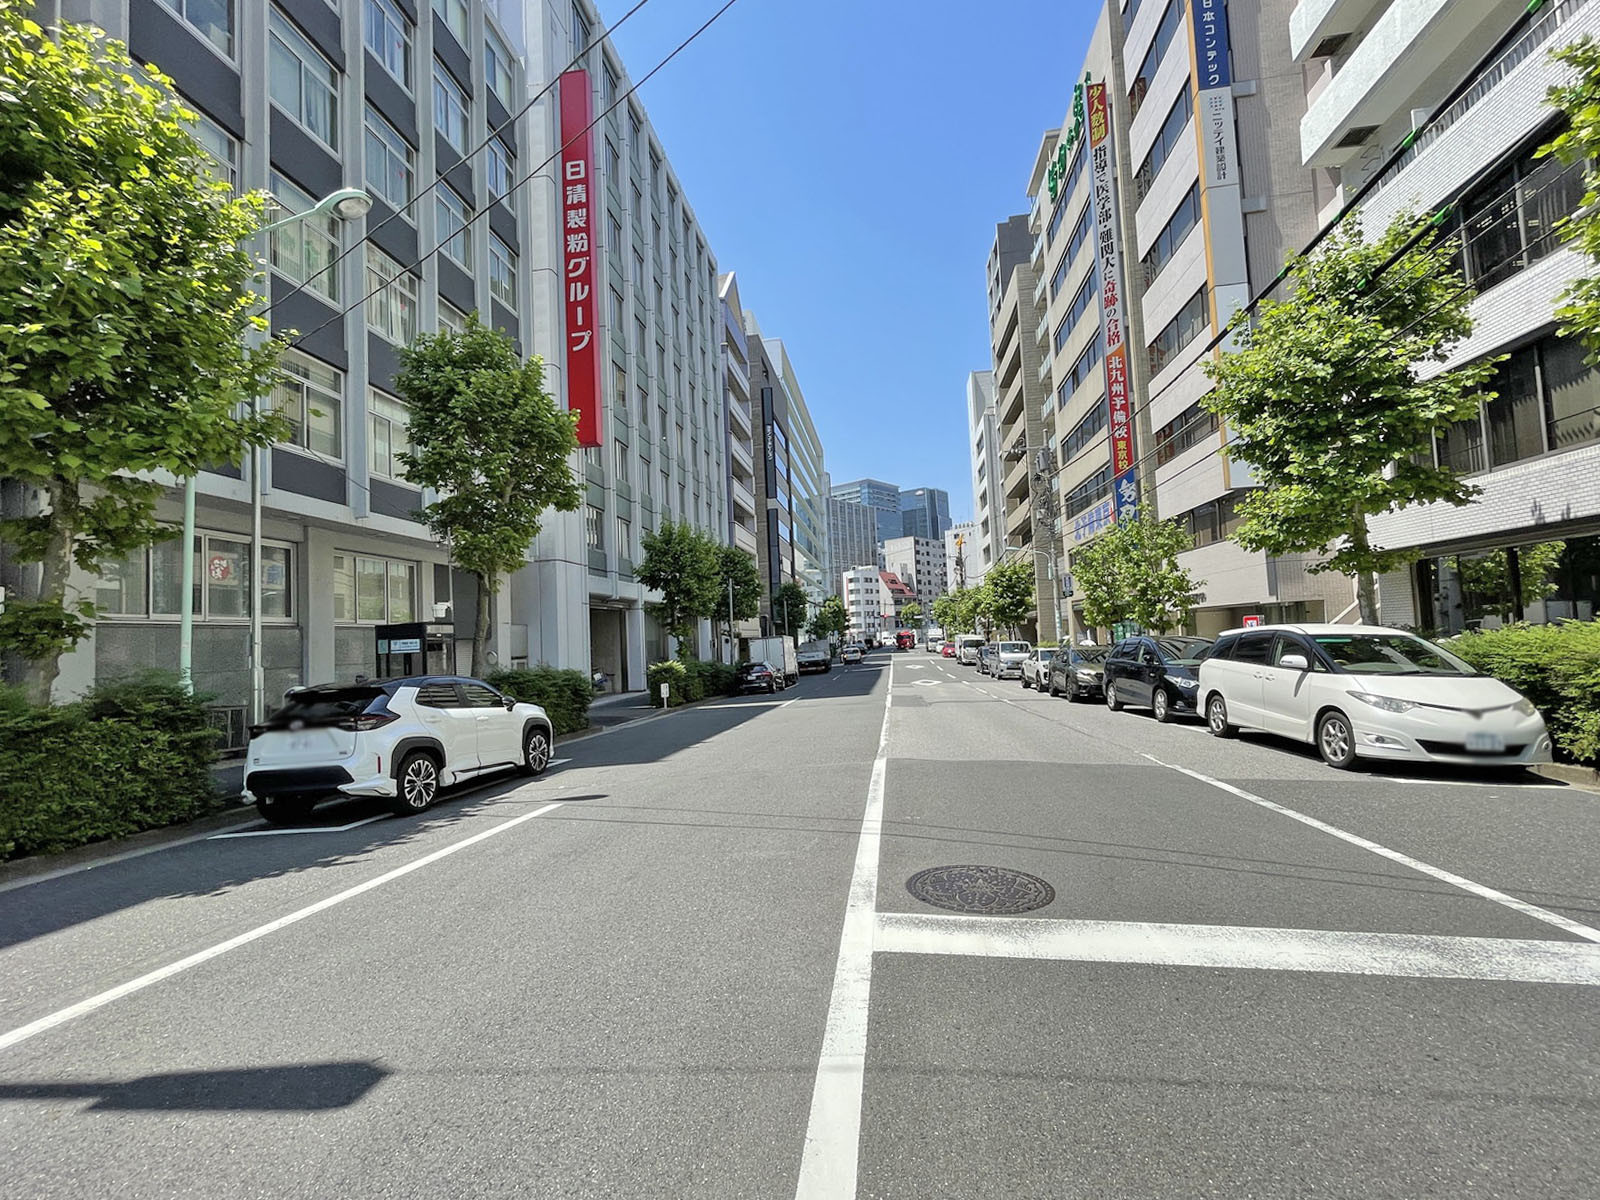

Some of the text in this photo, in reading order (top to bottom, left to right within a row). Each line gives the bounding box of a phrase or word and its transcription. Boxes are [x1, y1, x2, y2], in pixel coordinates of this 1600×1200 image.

[1202, 0, 1220, 85] 日本コンテック
[1089, 87, 1106, 141] 少人数制
[565, 159, 593, 352] 日清製粉グループ
[1109, 356, 1127, 438] 北九州予備校
[1116, 440, 1129, 471] 東京校
